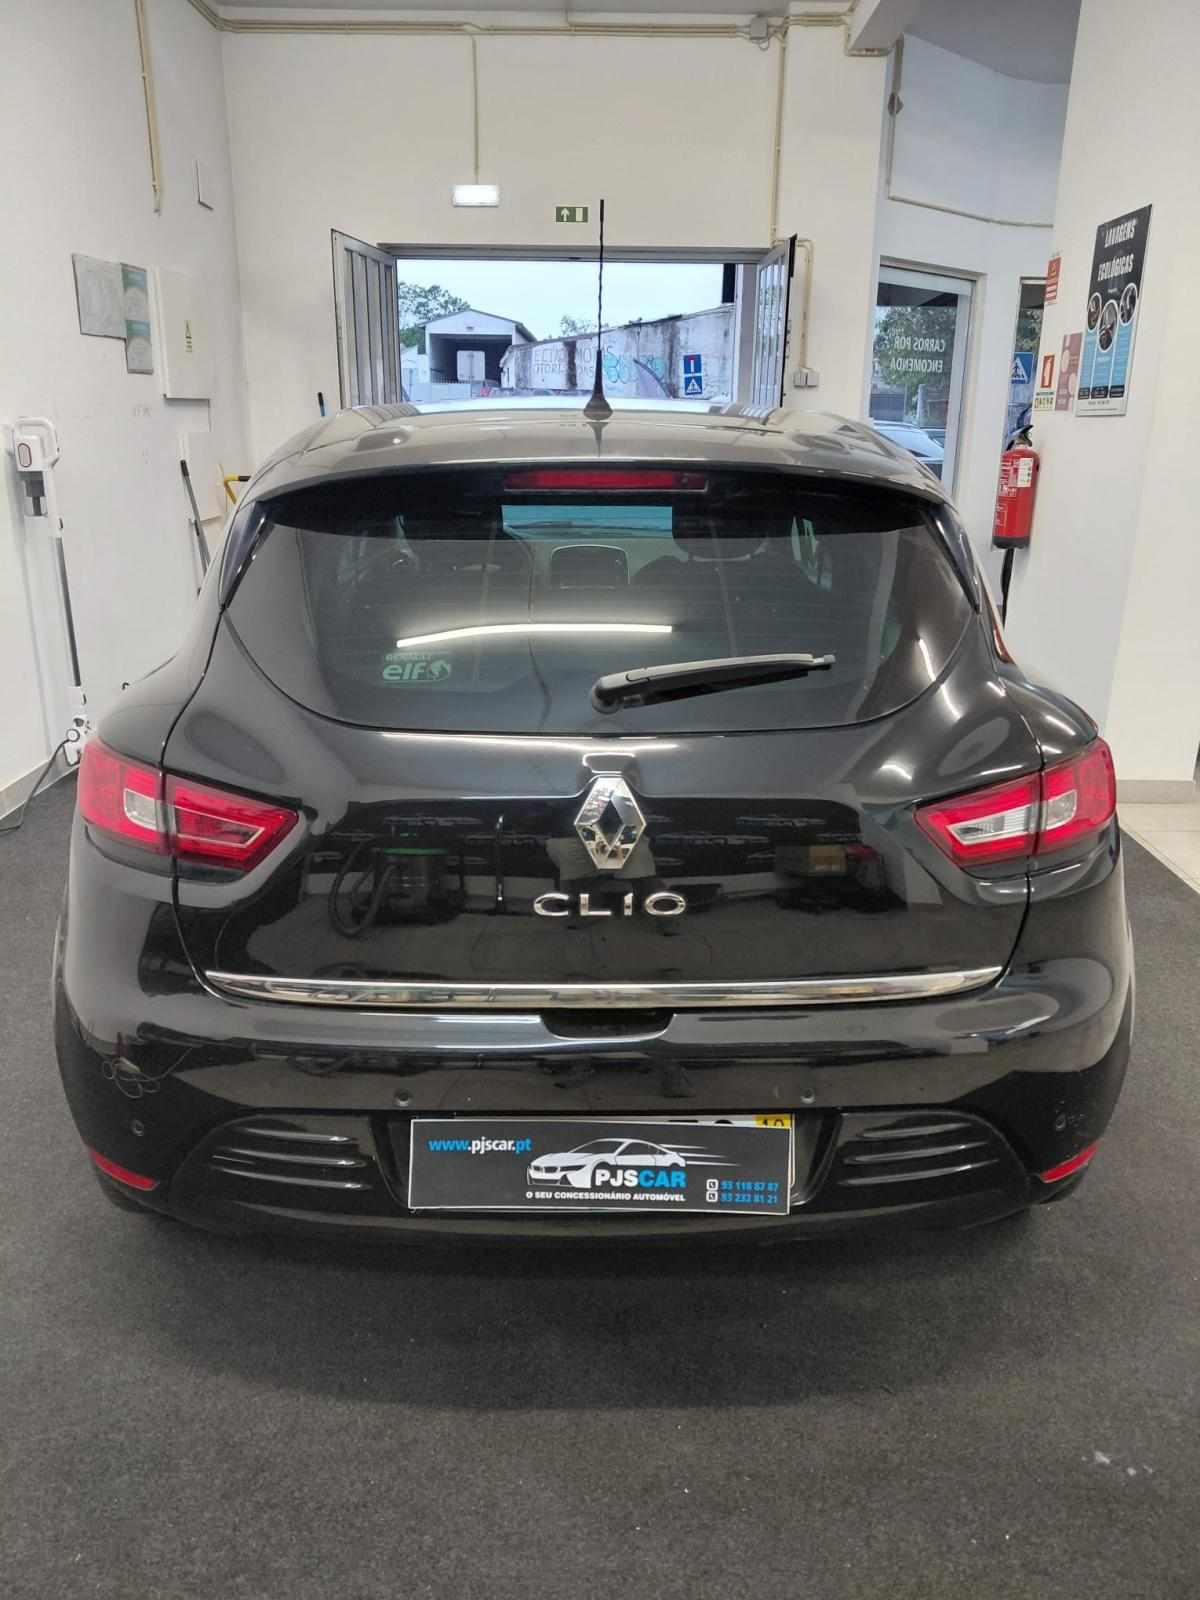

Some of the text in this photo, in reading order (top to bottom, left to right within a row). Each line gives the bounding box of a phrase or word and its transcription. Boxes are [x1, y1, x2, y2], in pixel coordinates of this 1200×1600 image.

[1104, 219, 1136, 248] LAVAGENS
[1098, 254, 1134, 281] ECOLÓGICAS
[533, 892, 687, 917] CLIO
[428, 1136, 532, 1154] www.pjscar.pt
[595, 1169, 687, 1188] PJSCAR
[525, 1190, 686, 1202] O SEU CONCESSIONÁRIO AUTOMÓVEL
